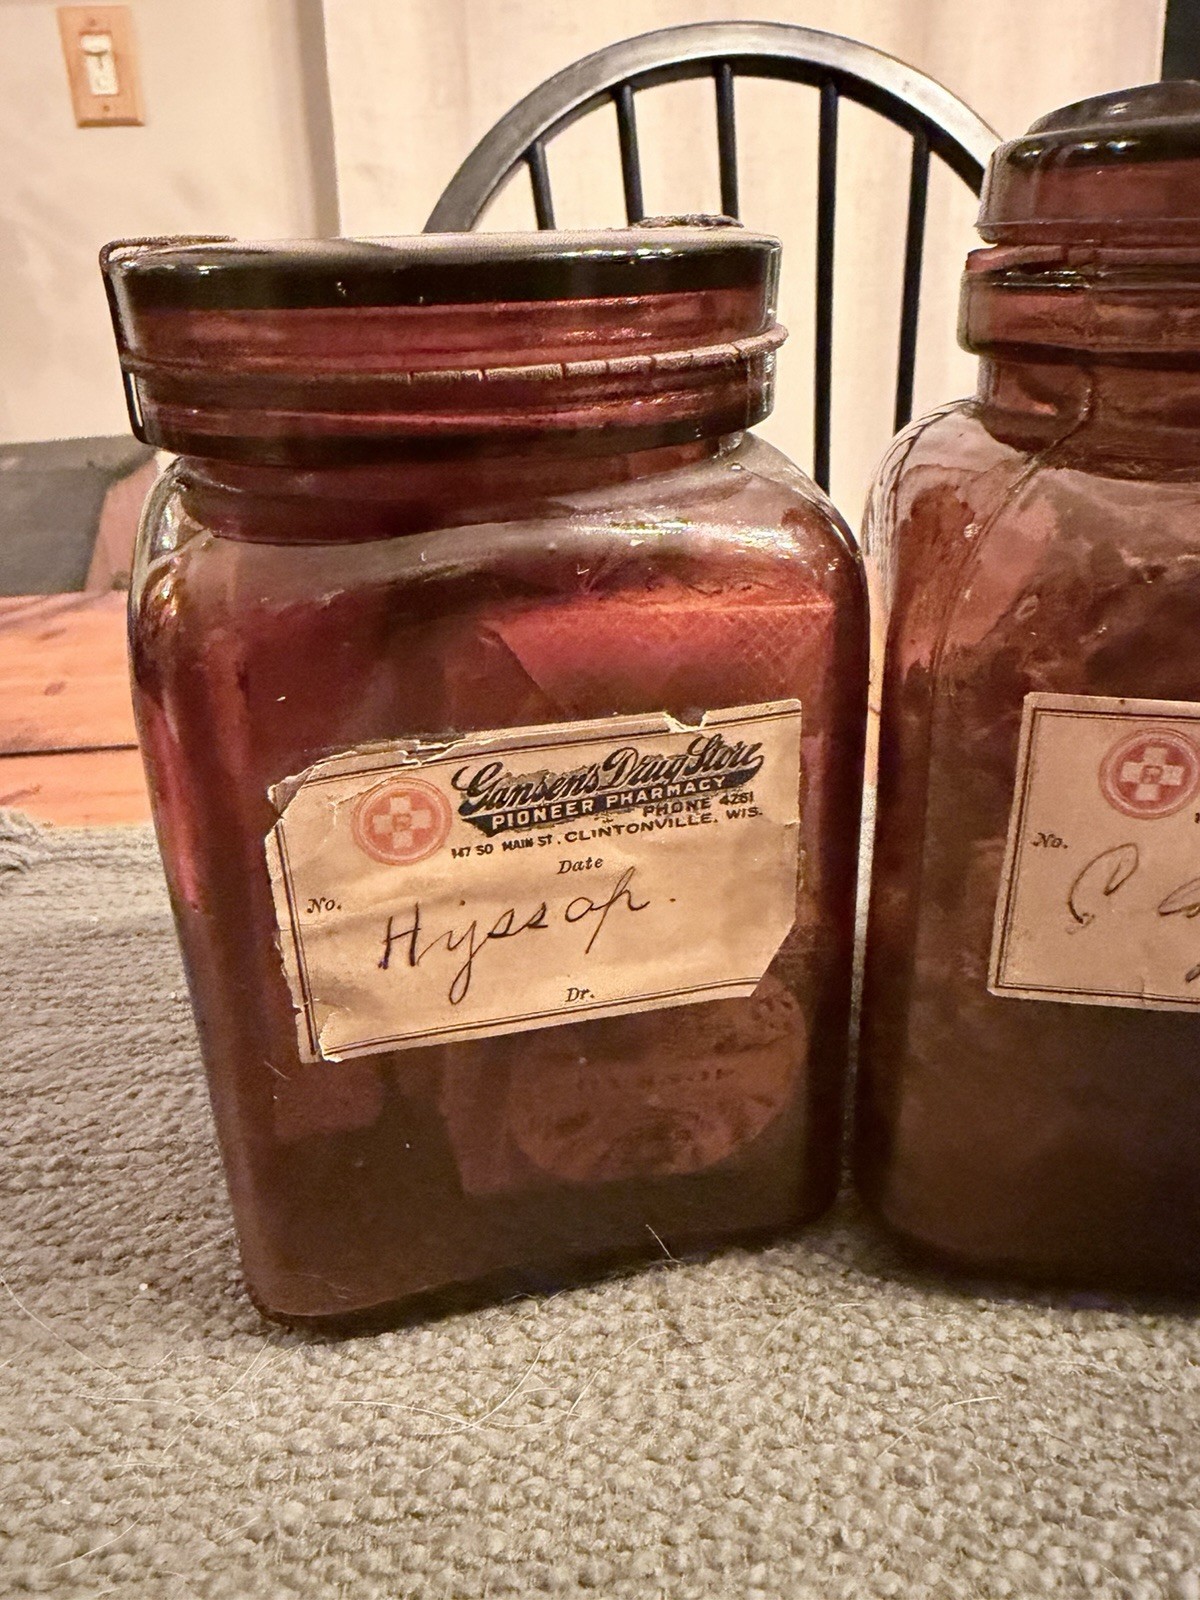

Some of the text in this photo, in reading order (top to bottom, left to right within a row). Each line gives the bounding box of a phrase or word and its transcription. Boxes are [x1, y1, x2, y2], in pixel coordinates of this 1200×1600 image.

[599, 746, 688, 787] Drug
[684, 732, 764, 777] Store
[491, 776, 726, 831] PIONEER PHARMACY
[643, 797, 711, 817] PHONE
[502, 838, 534, 852] MAIN
[726, 806, 764, 820] WIS.
[1032, 832, 1069, 850] No.
[557, 856, 604, 875] Date
[306, 898, 342, 914] No.
[565, 986, 595, 1003] Dr.
